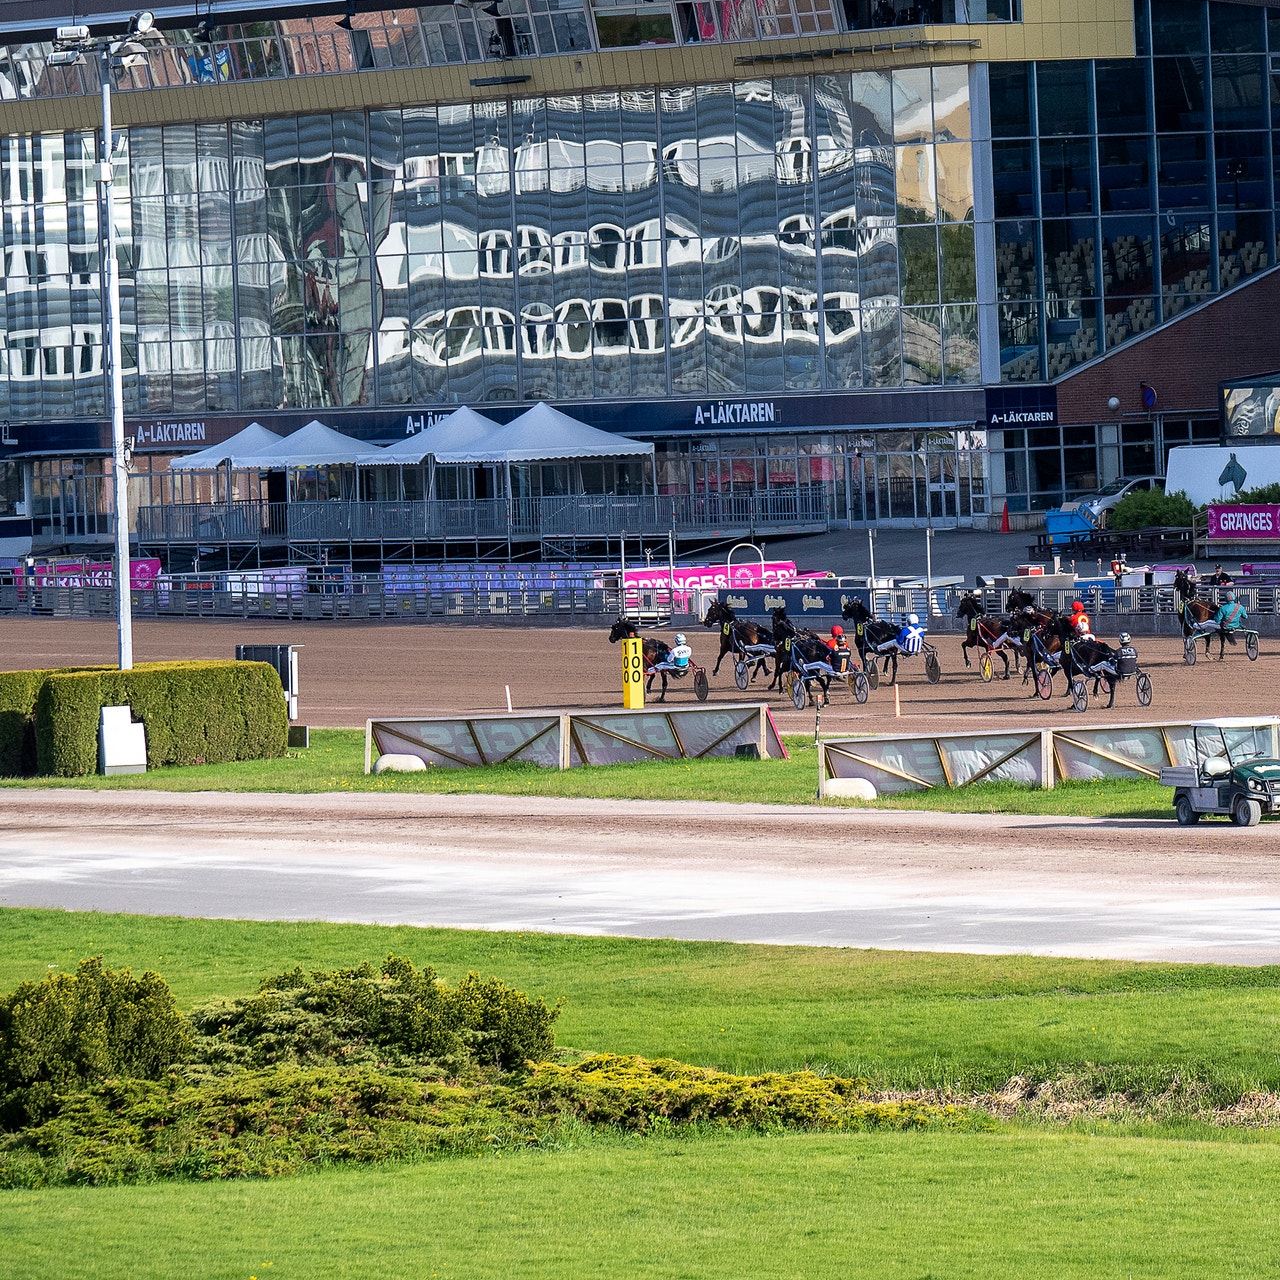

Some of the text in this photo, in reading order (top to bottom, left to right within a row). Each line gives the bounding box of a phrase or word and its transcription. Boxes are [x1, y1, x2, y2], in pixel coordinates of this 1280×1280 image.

[1166, 209, 1176, 226] G
[694, 401, 774, 425] A-LÄKTAREN
[991, 410, 1053, 424] A-LÄKTAREN
[137, 422, 205, 444] A-LÄKTAREN
[1220, 512, 1272, 531] GRÄNGES
